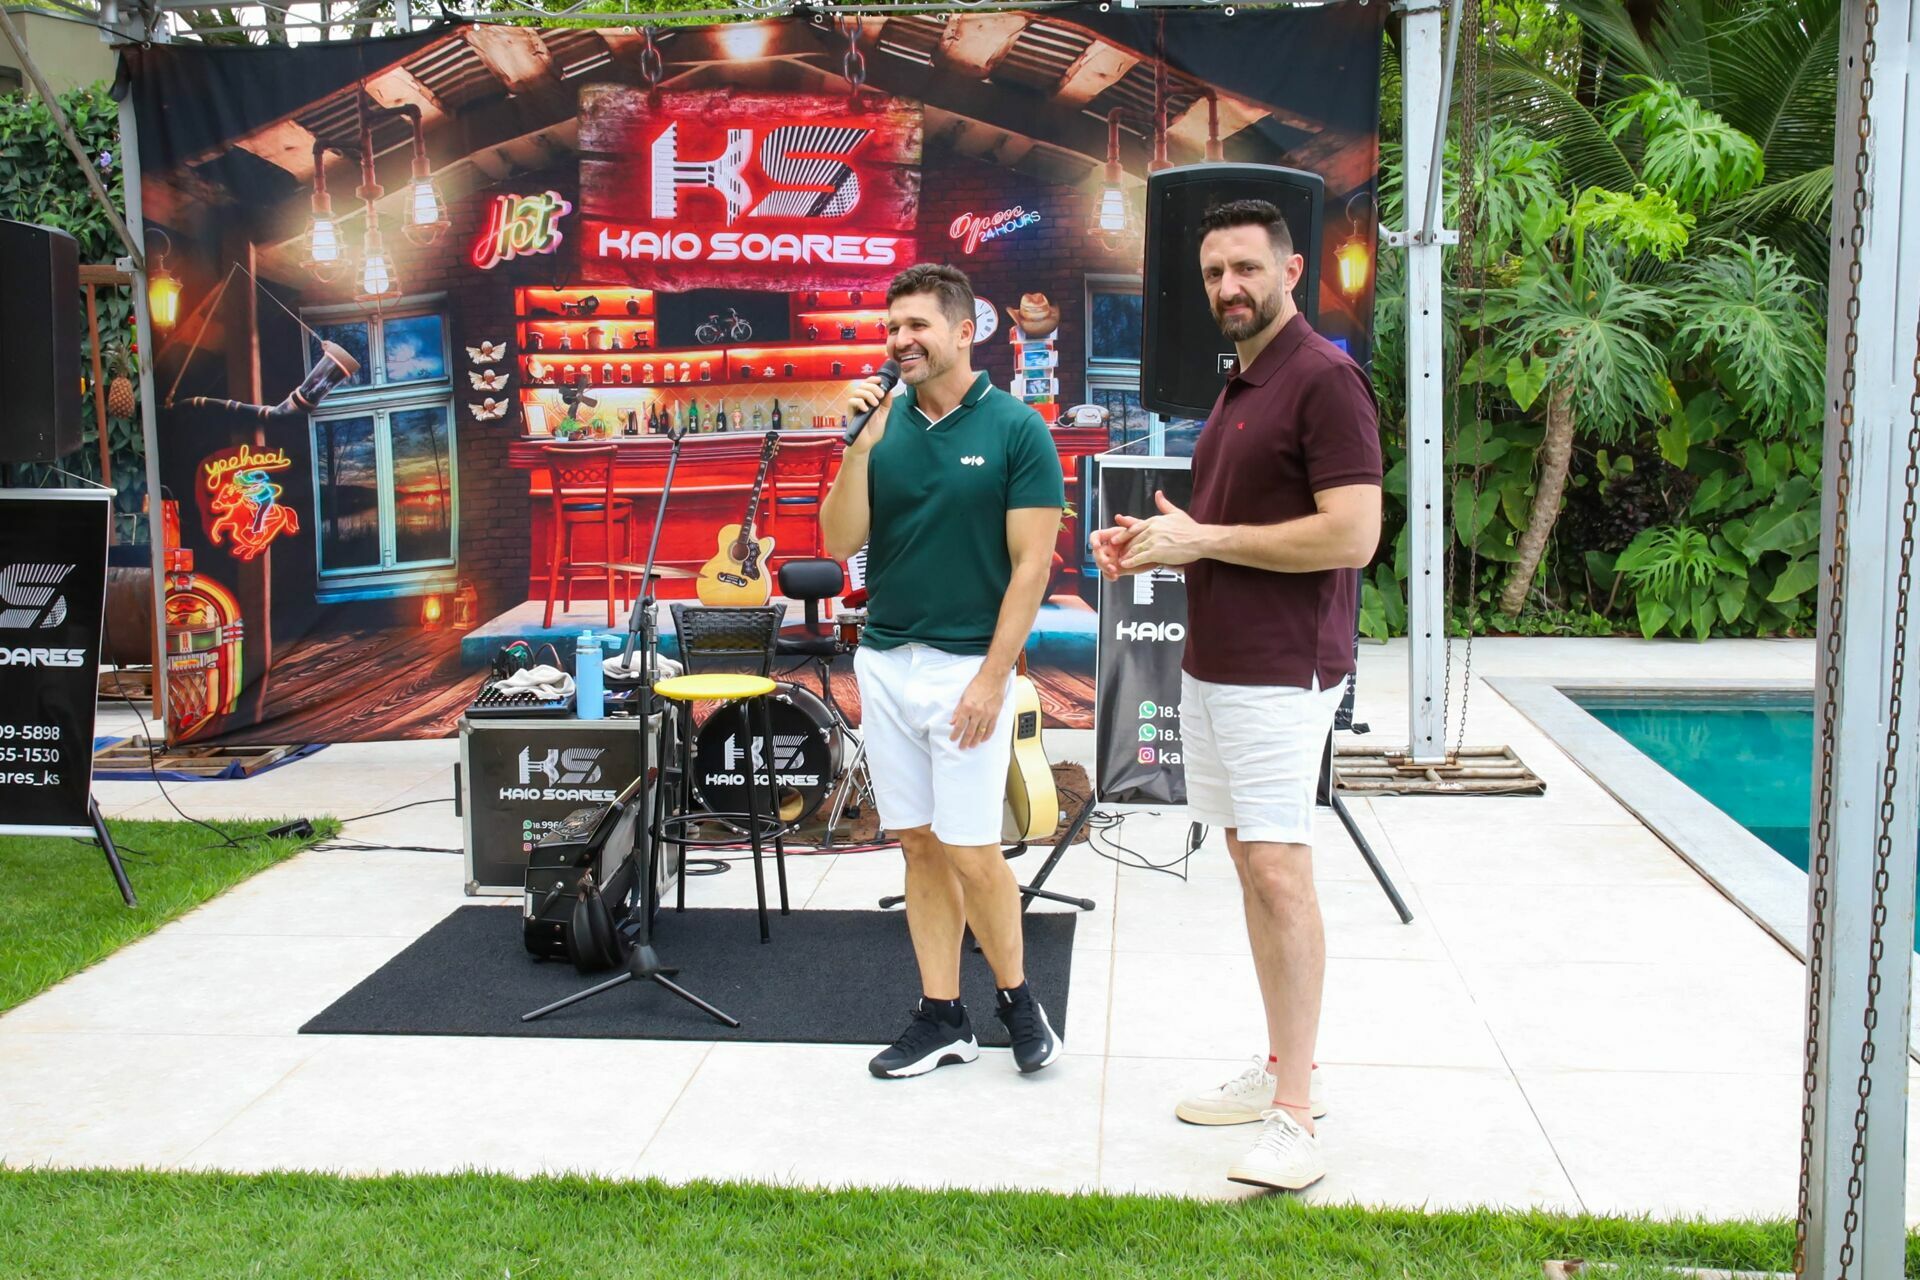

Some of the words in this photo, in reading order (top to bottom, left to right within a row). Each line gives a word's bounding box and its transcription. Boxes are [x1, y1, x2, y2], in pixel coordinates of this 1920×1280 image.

[651, 120, 875, 227] KS
[473, 191, 570, 267] Hot
[599, 227, 702, 262] KAIO
[706, 232, 899, 265] SOARES
[1116, 620, 1185, 642] KAIO
[1158, 729, 1182, 742] 18.
[518, 745, 606, 788] KS
[705, 773, 745, 786] KAIO
[499, 787, 541, 801] KAIO
[542, 788, 617, 802] SOARES
